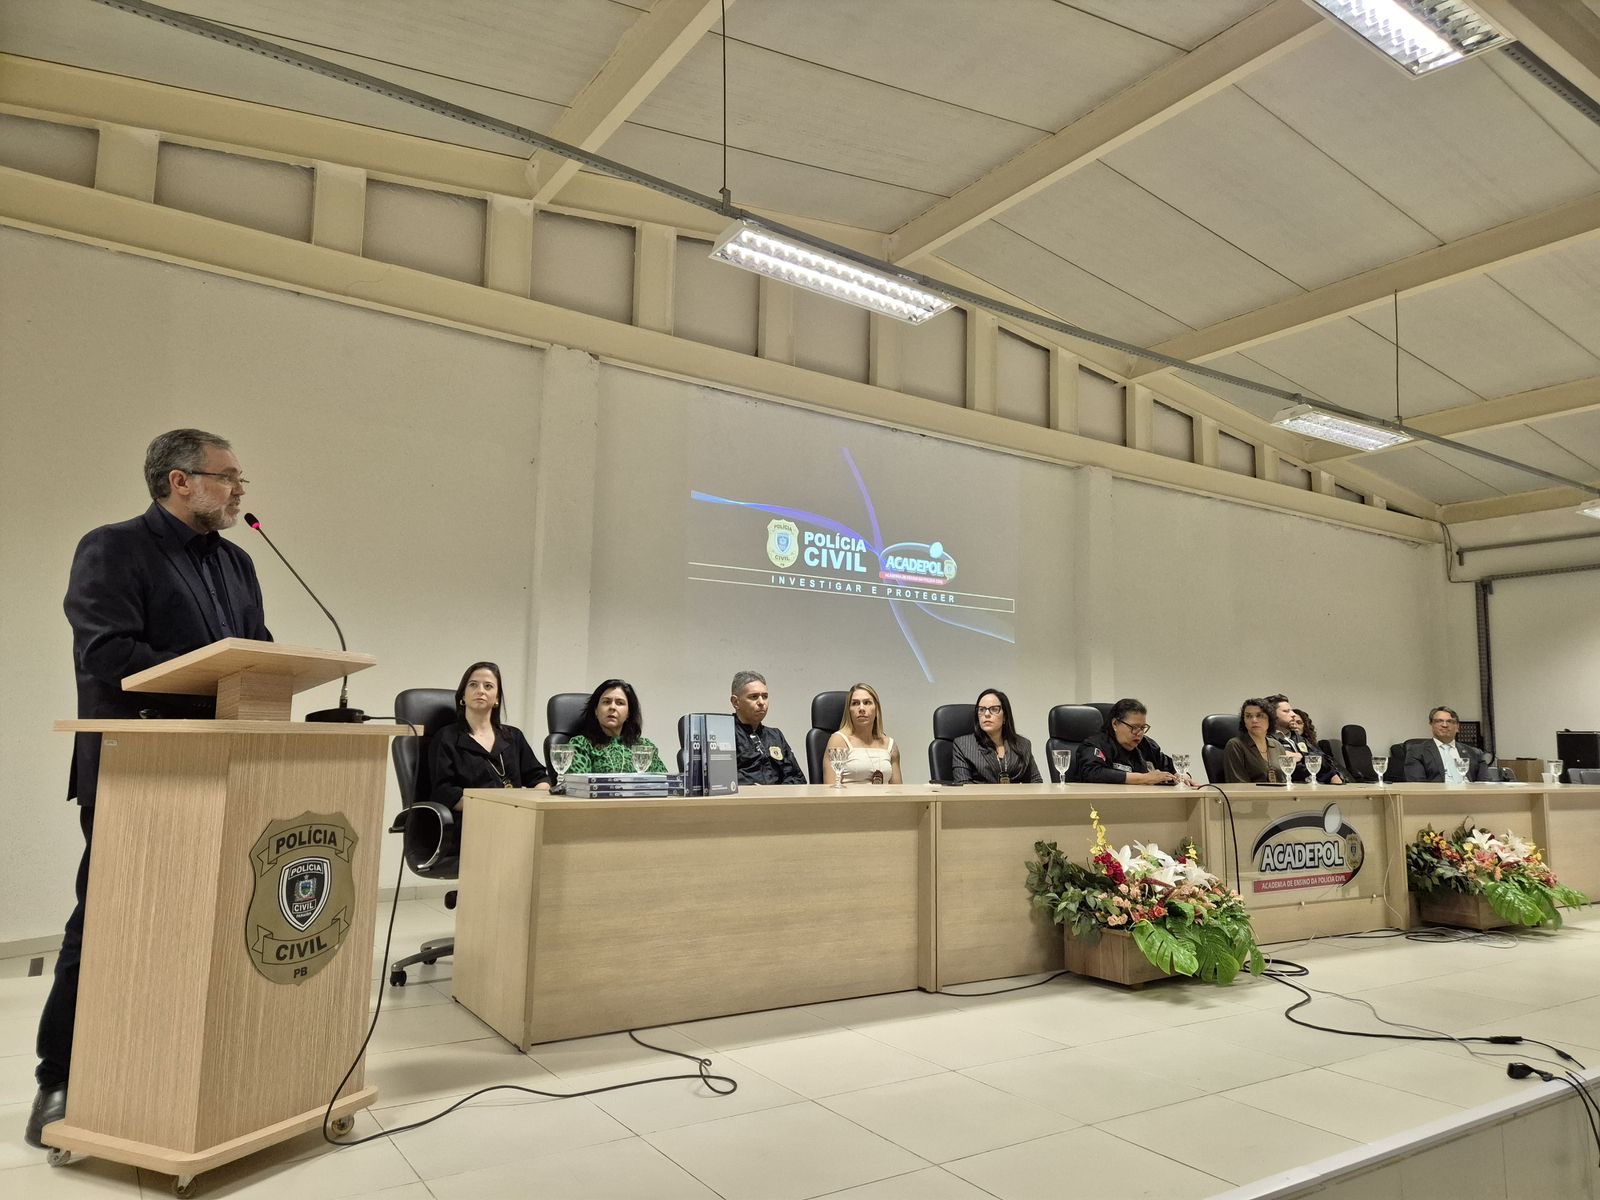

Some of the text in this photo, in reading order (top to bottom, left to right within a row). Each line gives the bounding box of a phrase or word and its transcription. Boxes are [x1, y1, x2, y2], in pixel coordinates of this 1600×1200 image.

[804, 531, 867, 553] POLÍCIA
[774, 554, 790, 562] CIVIL
[804, 547, 867, 573] CIVIL
[886, 556, 944, 577] ACADEPOL
[771, 575, 955, 603] INVESTIGAR E PROTEGER
[275, 826, 338, 855] POLÍCIA
[1260, 841, 1345, 872] ACADEPOL
[293, 902, 314, 912] CIVIL
[275, 936, 328, 961] CIVIL
[293, 967, 308, 979] PB
